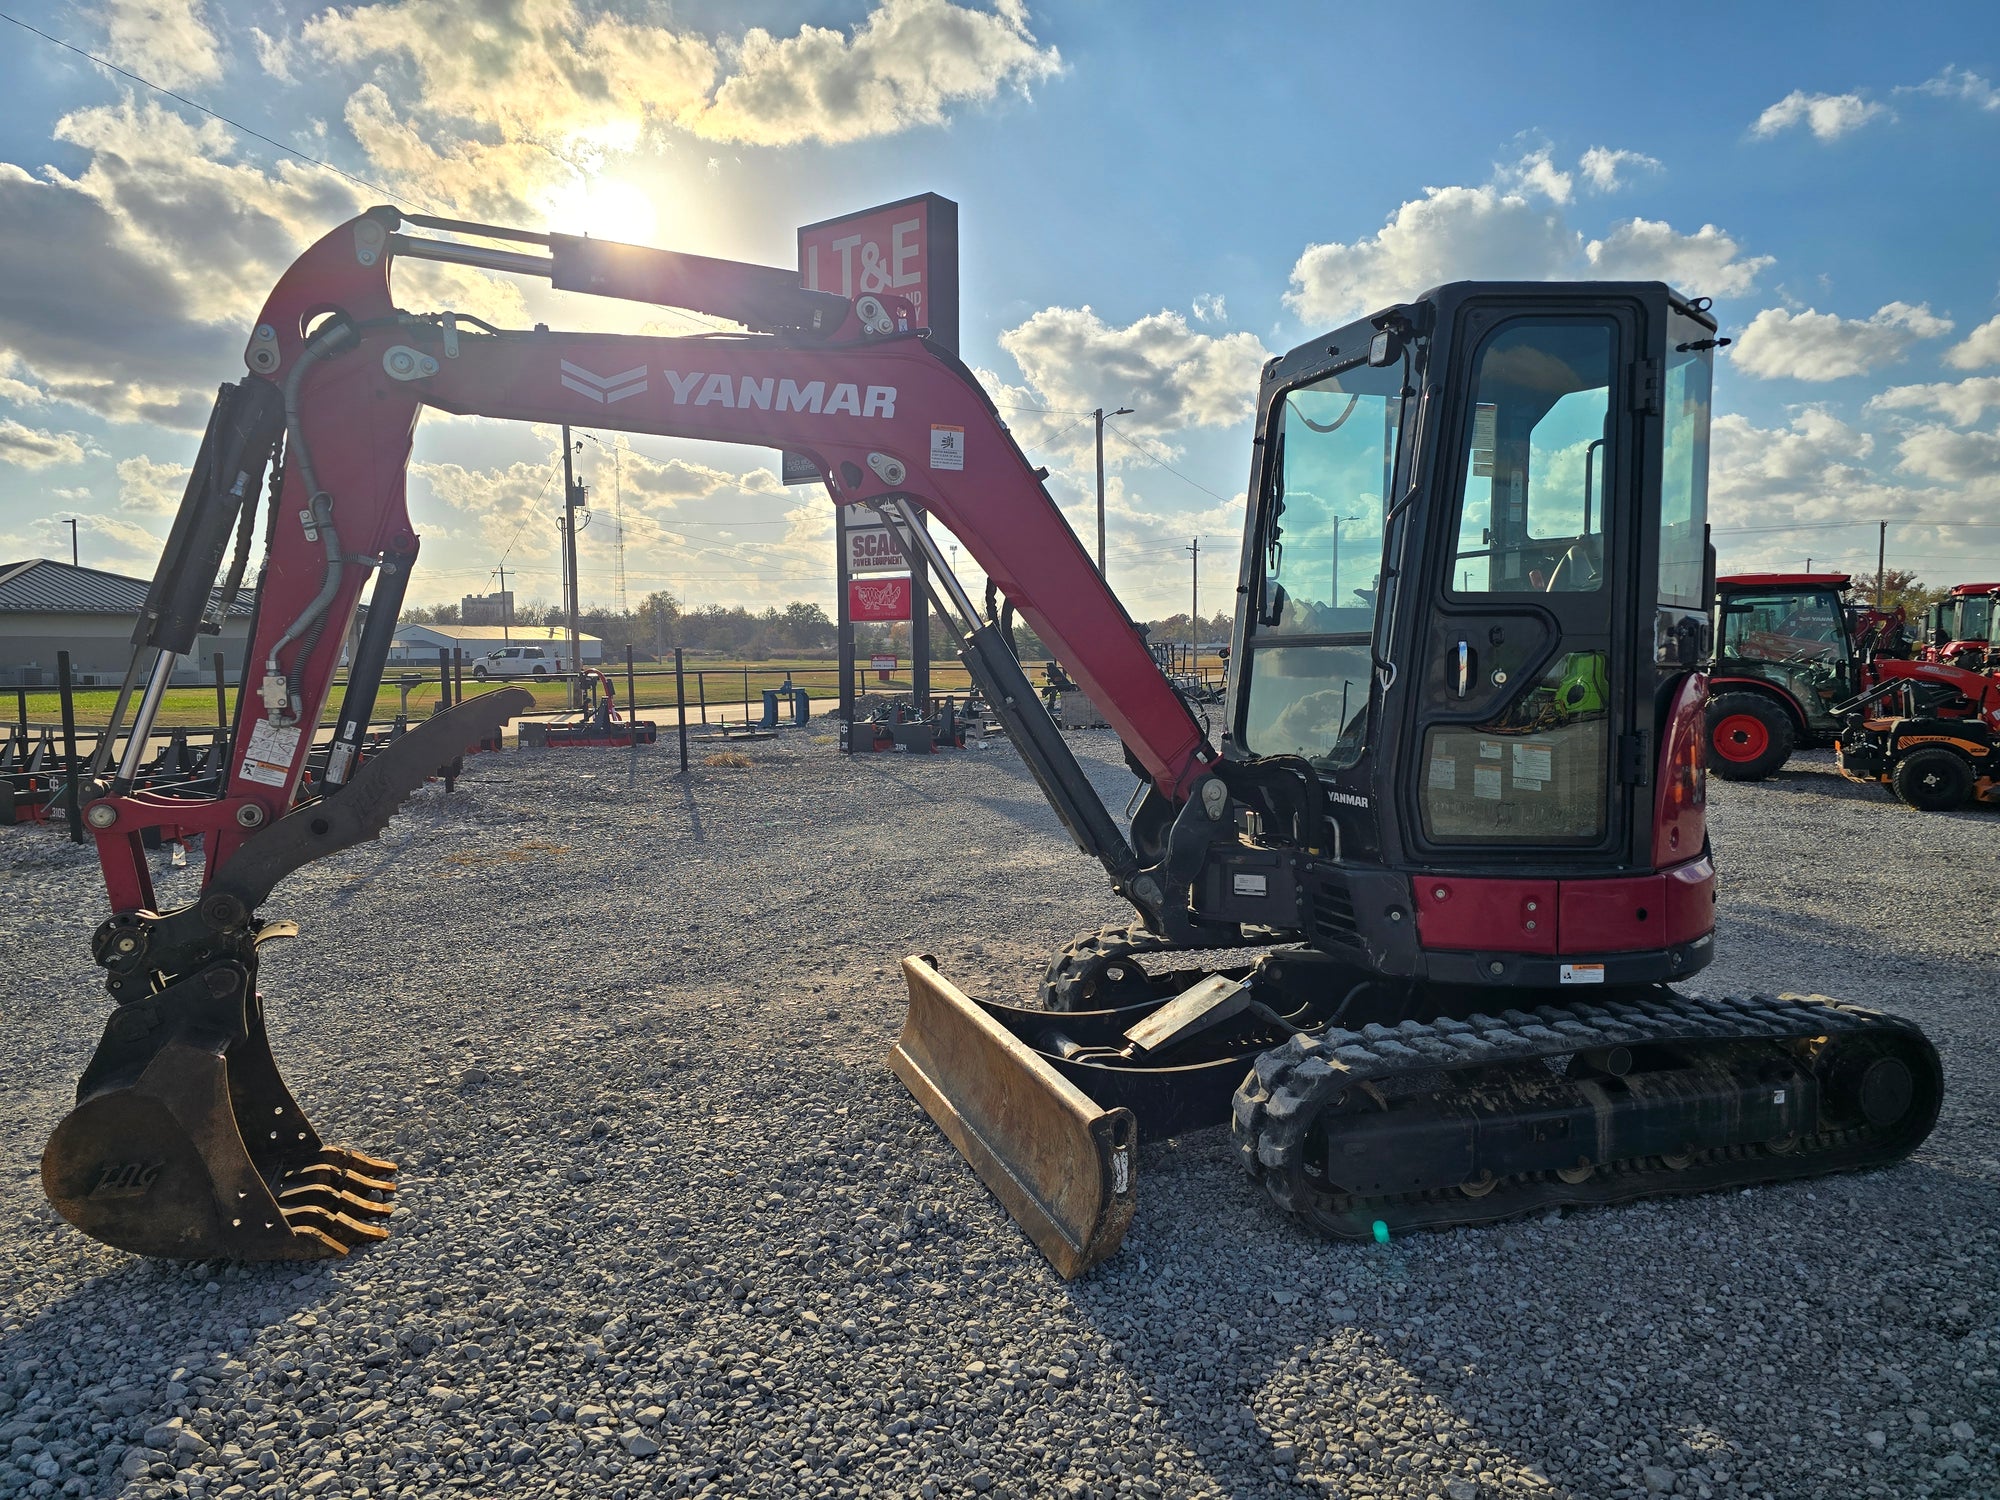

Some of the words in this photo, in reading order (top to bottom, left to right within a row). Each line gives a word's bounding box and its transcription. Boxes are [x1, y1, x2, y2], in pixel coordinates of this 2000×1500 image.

[664, 369, 897, 419] YANMAR
[853, 557, 871, 567] POWER
[872, 556, 903, 566] EQUIPMENT
[1327, 791, 1369, 808] YANMAR
